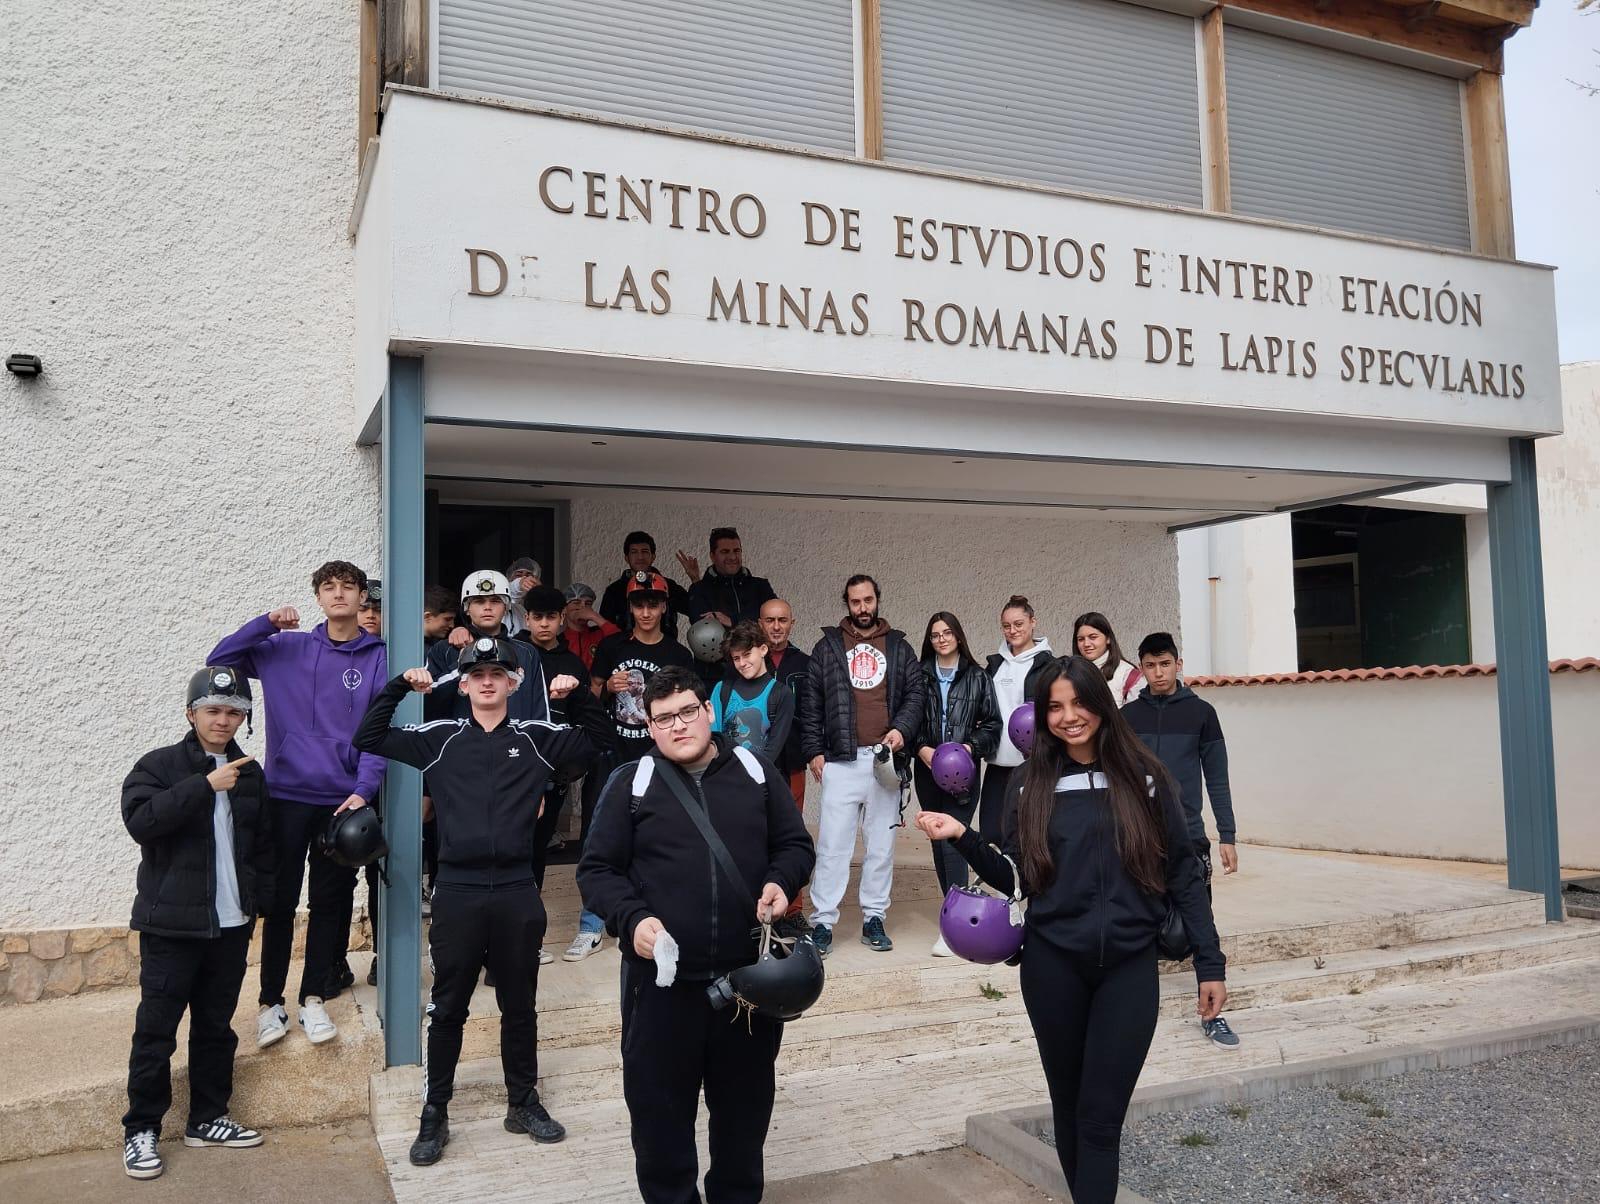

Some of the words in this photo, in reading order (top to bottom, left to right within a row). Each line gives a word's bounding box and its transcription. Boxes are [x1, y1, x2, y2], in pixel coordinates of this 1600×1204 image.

[464, 247, 540, 300] D
[584, 261, 672, 316] LAS
[706, 276, 869, 337] MINAS
[902, 298, 1118, 361] ROMANAS
[1143, 323, 1195, 368] DE
[1219, 332, 1317, 381] LAPIS
[1340, 344, 1525, 400] SPECVLARIS
[538, 165, 767, 240] CENTRO
[801, 201, 862, 253] DE
[893, 215, 1106, 284] ESTVDIOS
[1132, 247, 1153, 289] E
[1178, 254, 1482, 329] INTERPETACIÓN
[854, 680, 874, 688] 1910
